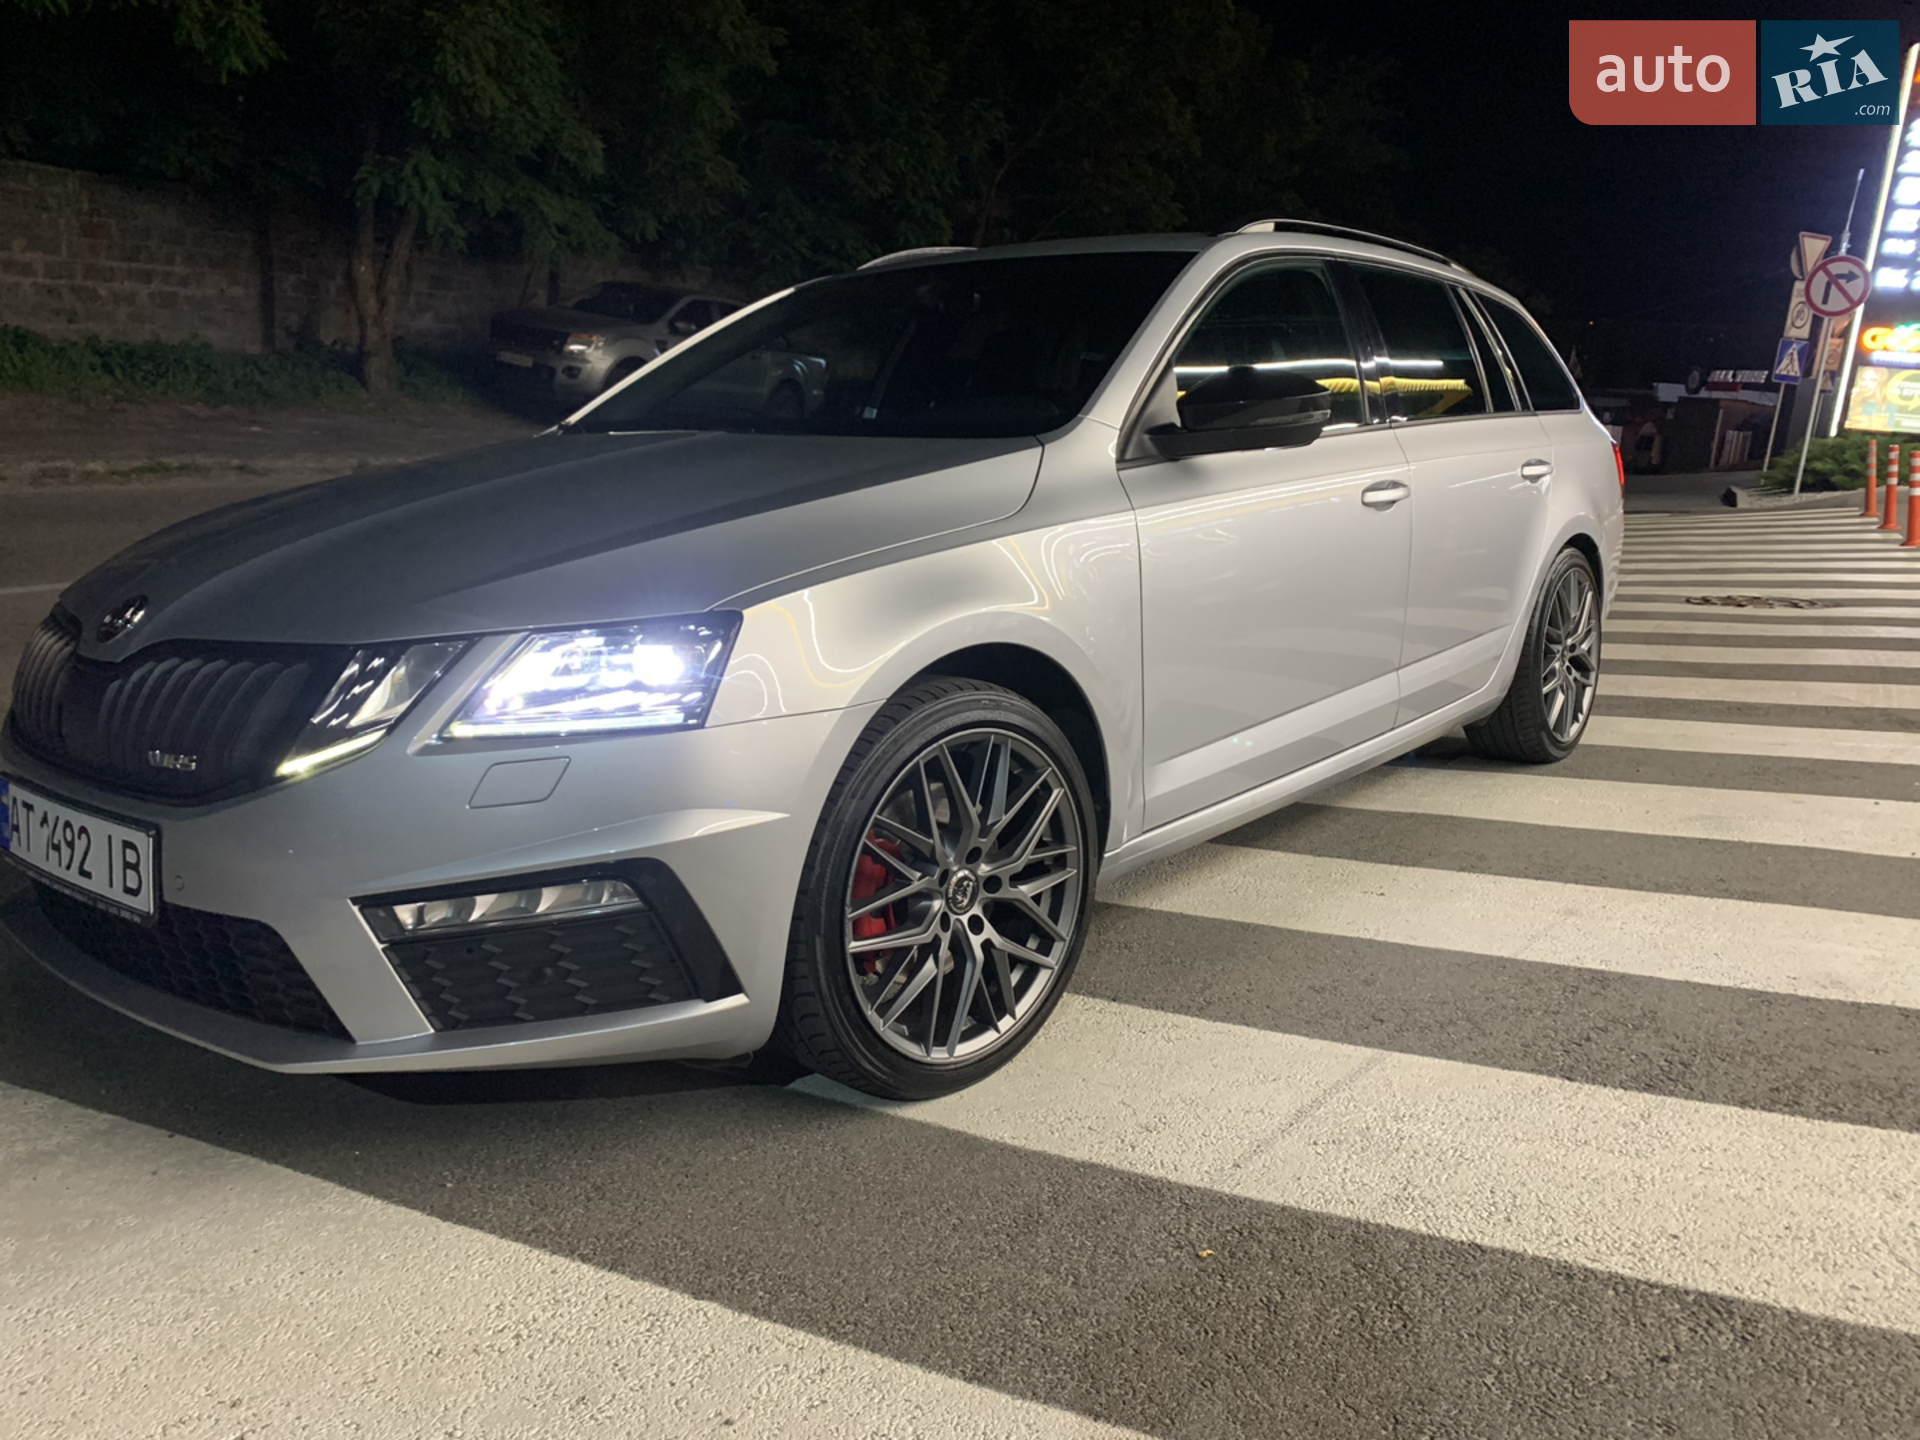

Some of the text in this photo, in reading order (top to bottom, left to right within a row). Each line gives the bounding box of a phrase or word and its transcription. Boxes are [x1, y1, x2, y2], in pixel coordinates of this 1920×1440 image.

[10, 796, 35, 852] AT
[39, 810, 93, 880] 1492
[108, 833, 143, 898] IB
